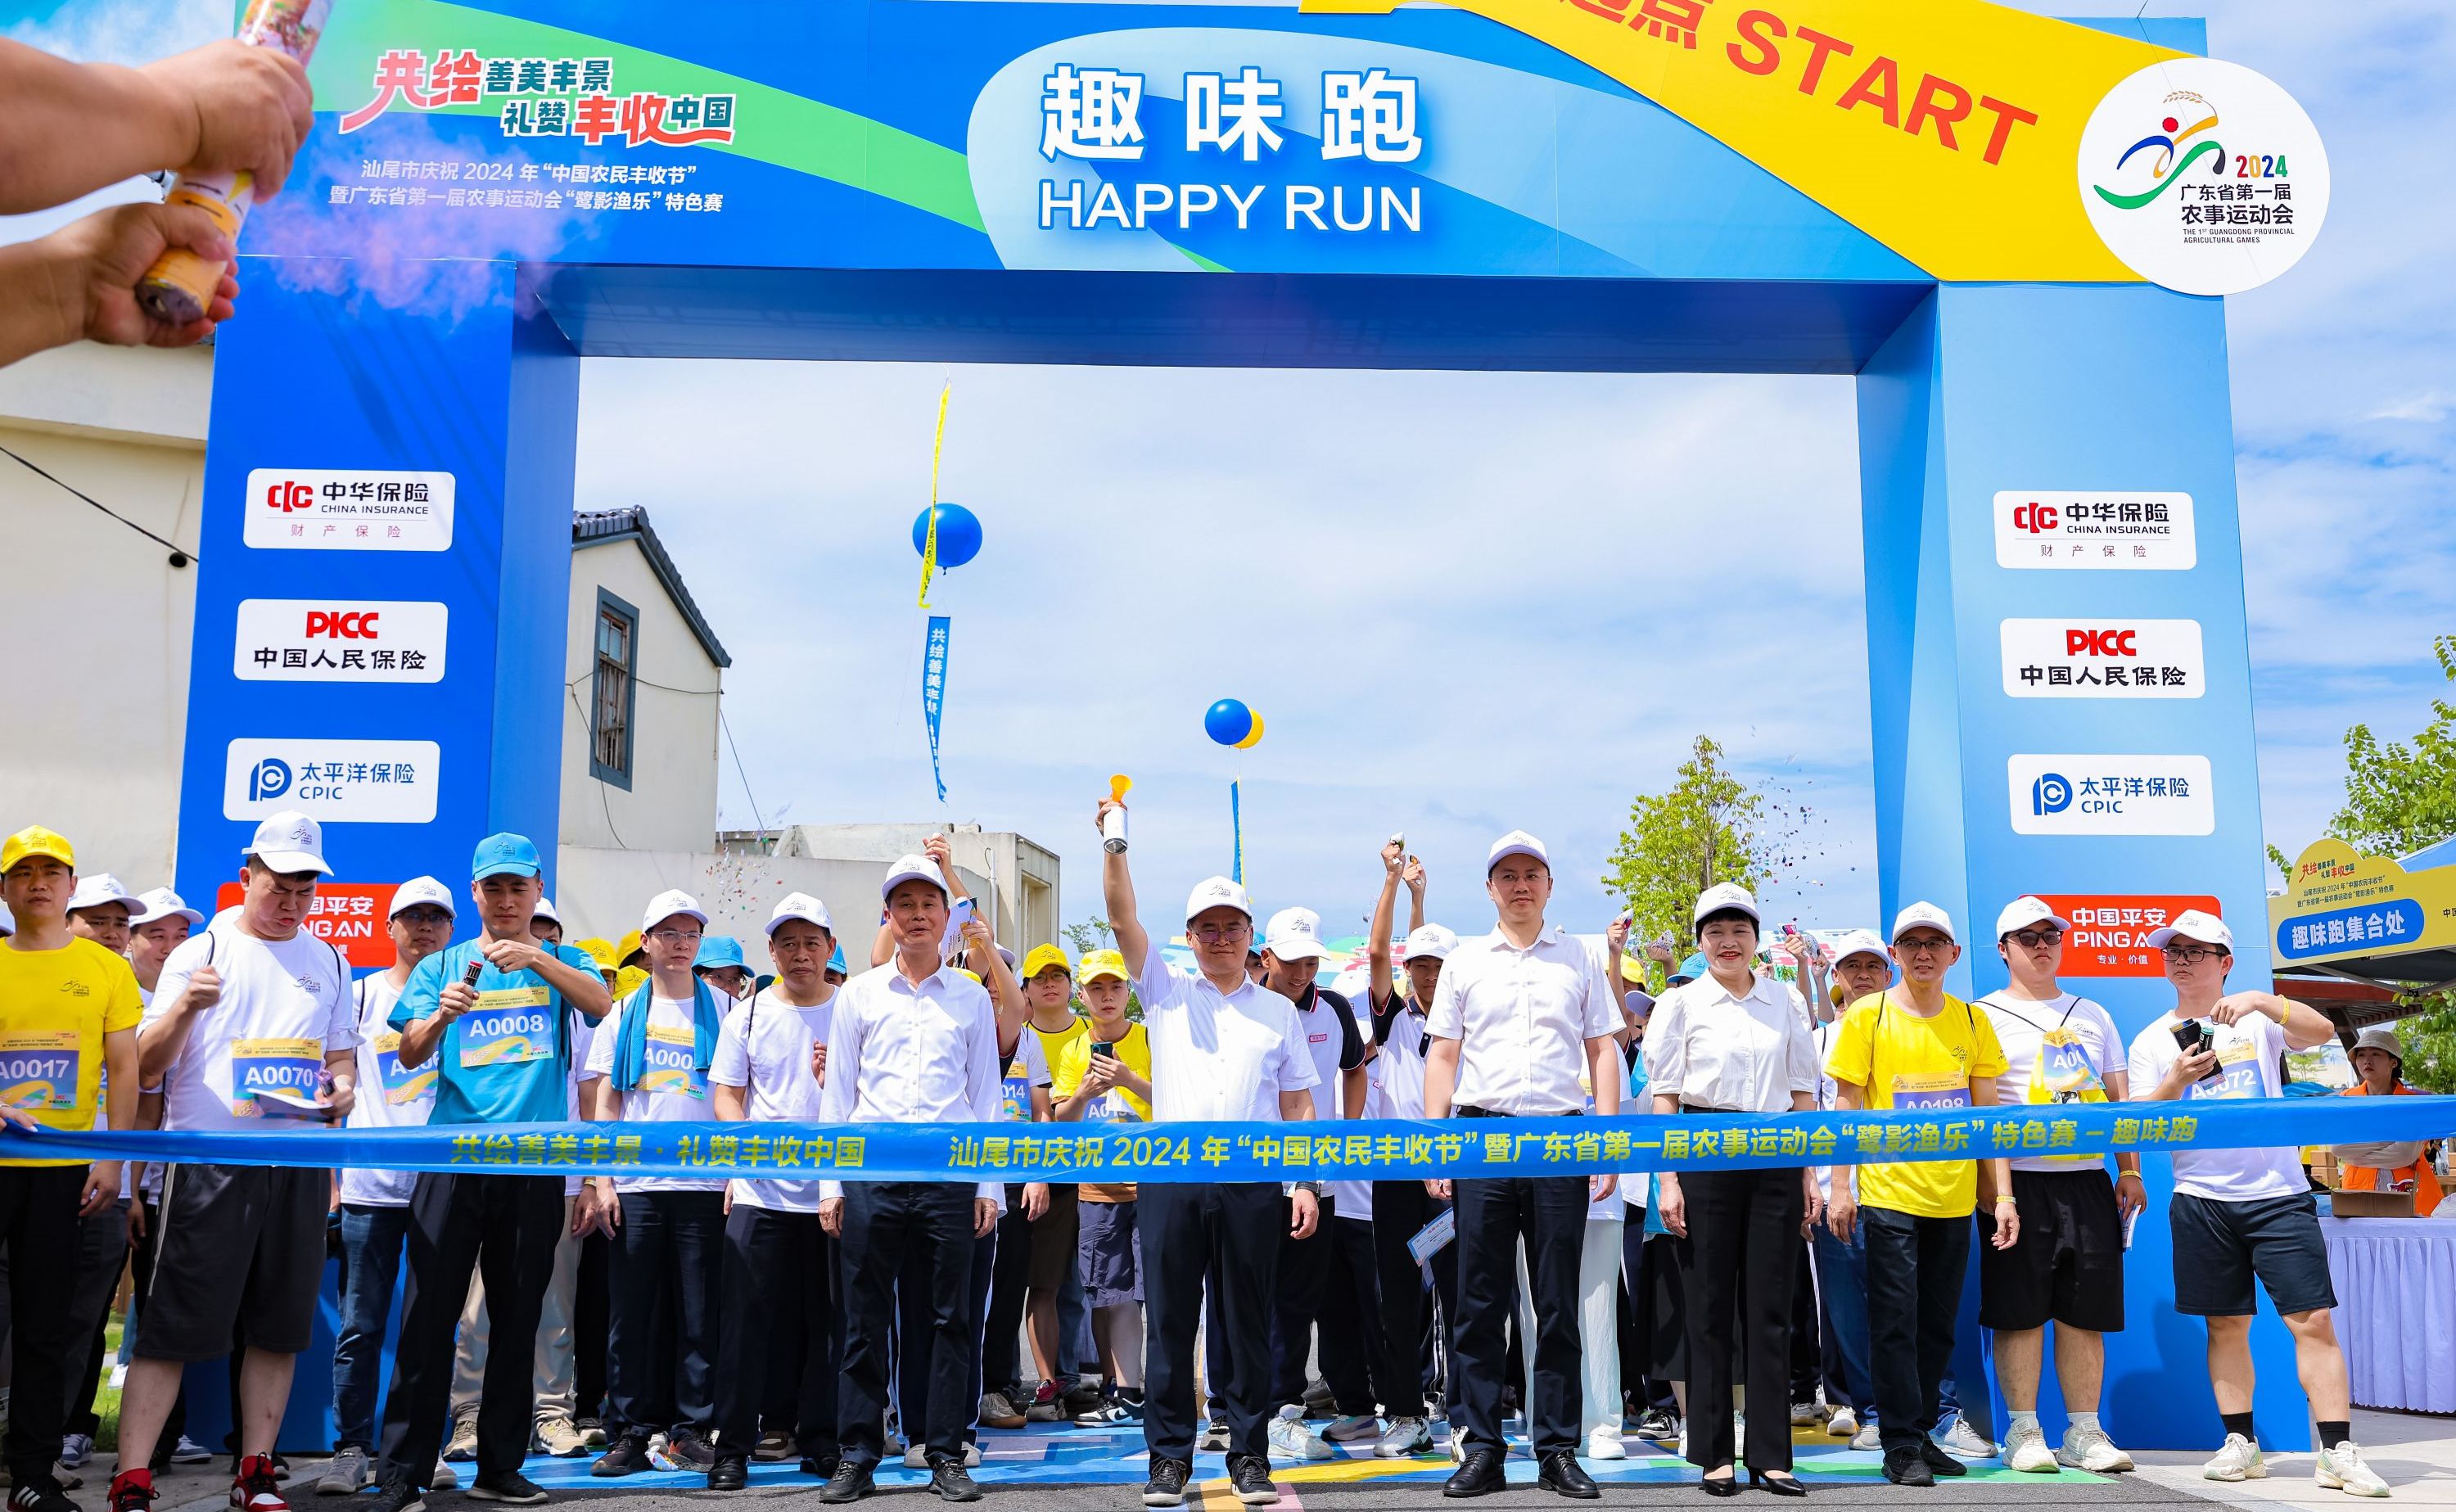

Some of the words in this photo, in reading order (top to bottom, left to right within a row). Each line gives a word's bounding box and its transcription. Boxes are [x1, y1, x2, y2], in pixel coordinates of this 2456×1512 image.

[341, 50, 613, 133] 共绘善美丰景
[1560, 0, 1713, 50] 点
[1726, 9, 2038, 166] START
[502, 93, 735, 147] 礼赞丰收中国
[1041, 64, 1423, 163] 趣味跑
[463, 162, 514, 181] 2024
[2235, 155, 2287, 178] 2024
[2180, 183, 2291, 201] 广东省第一届
[1041, 181, 1266, 230] HAPPY
[1285, 186, 1421, 232] RUN
[2181, 204, 2293, 225] 农事运动会
[2183, 228, 2196, 236] THE
[322, 482, 429, 503] 中华保险
[321, 505, 356, 513] CHINA
[362, 505, 428, 514] INSURANCE
[2065, 503, 2169, 522] 中华保险
[291, 524, 401, 538] 财产保险
[2067, 526, 2102, 534] CHINA
[2106, 526, 2170, 535] INSURANCE
[2041, 545, 2147, 557] 财产保险
[305, 612, 379, 639] PICC
[2066, 630, 2137, 656] PICC
[253, 647, 427, 670] 中国人民保险
[2020, 665, 2186, 686] 中国人民保险
[300, 762, 415, 783] 太平洋保险
[299, 786, 343, 800] CPIC
[2079, 777, 2189, 797] 太平洋保险
[2081, 801, 2124, 814] CPIC
[2072, 907, 2167, 928] 中国平安
[2292, 909, 2405, 950] 趣味跑集合处
[469, 1014, 544, 1037] A0008
[0, 1059, 70, 1079] A0017
[645, 1048, 697, 1071] A000
[244, 1066, 314, 1087] A0070
[948, 1135, 1104, 1169] 汕尾市庆祝
[1111, 1135, 1191, 1167] 2024
